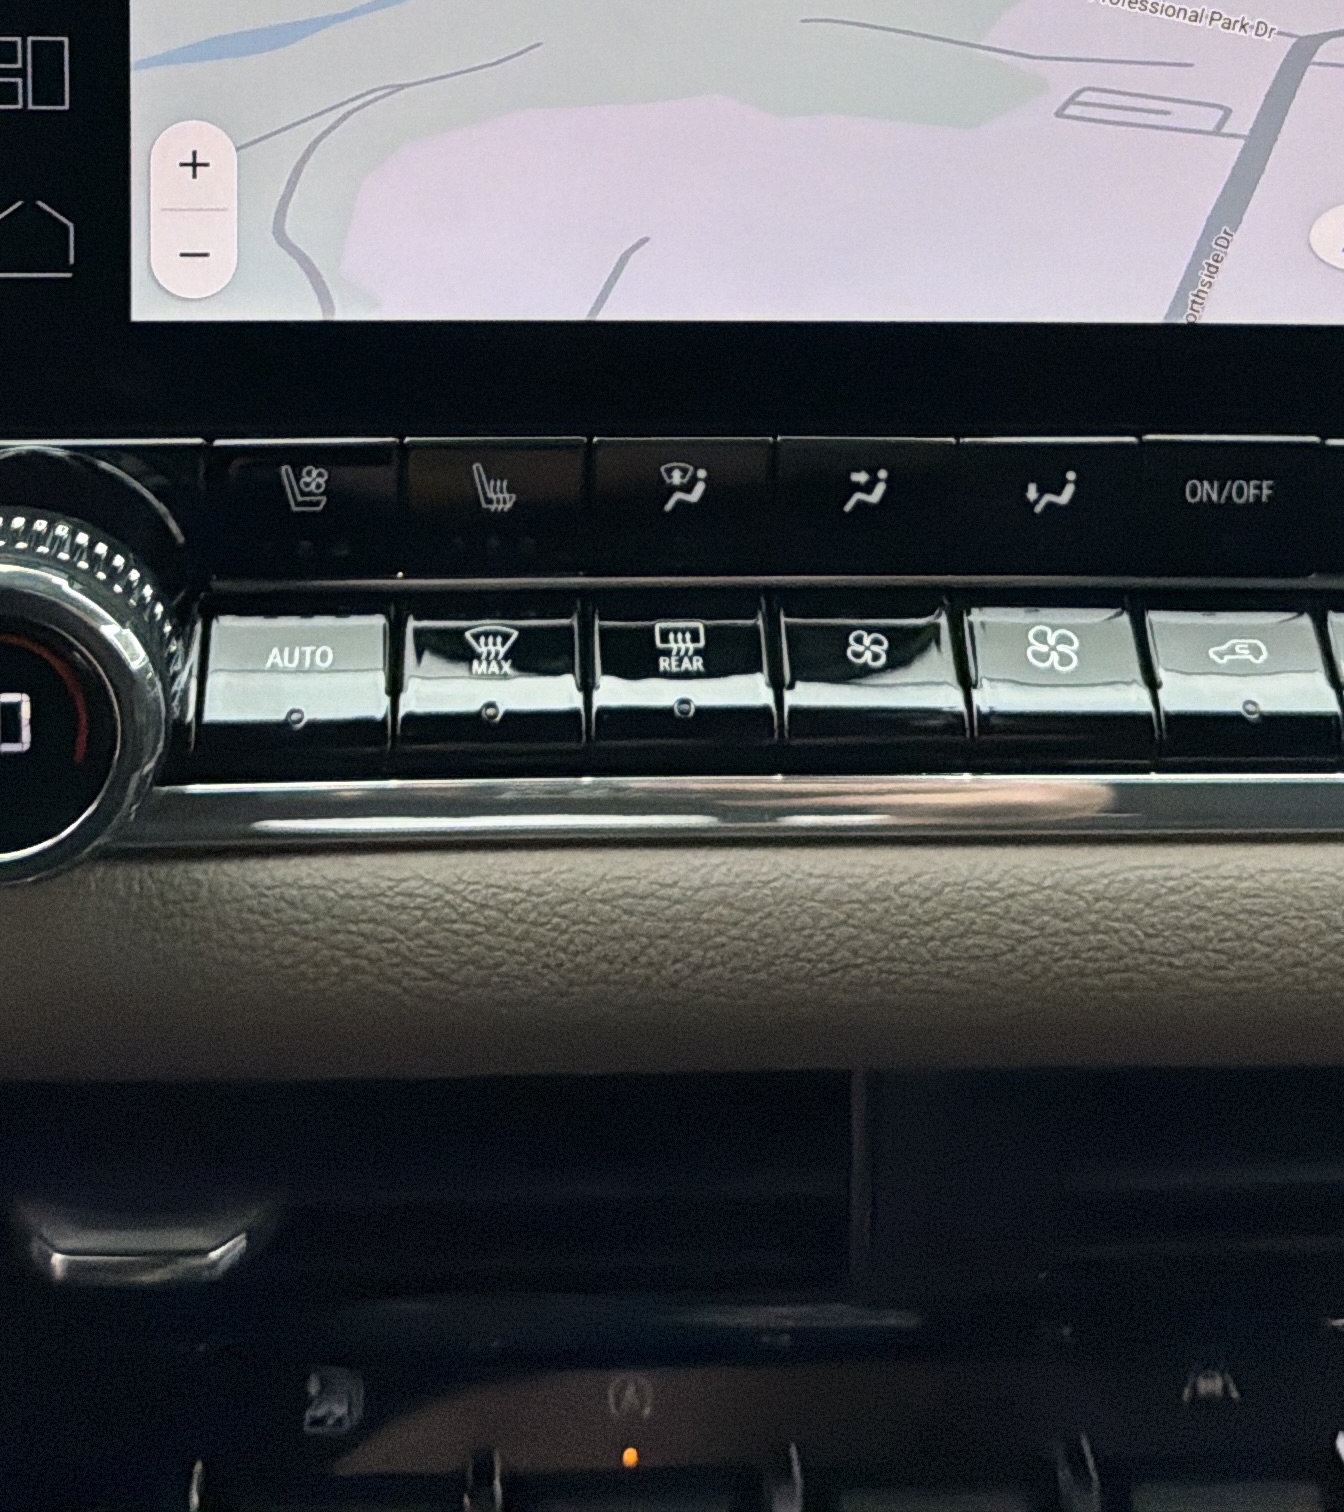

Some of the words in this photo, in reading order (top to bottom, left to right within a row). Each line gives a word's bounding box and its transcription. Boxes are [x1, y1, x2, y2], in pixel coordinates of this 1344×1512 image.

[1208, 10, 1249, 34] Park
[1255, 21, 1276, 39] Dr
[1213, 226, 1235, 253] Dr
[1185, 479, 1274, 503] ON/OFF
[265, 644, 334, 669] AUTO
[471, 659, 512, 676] MAX
[658, 655, 705, 672] REAR
